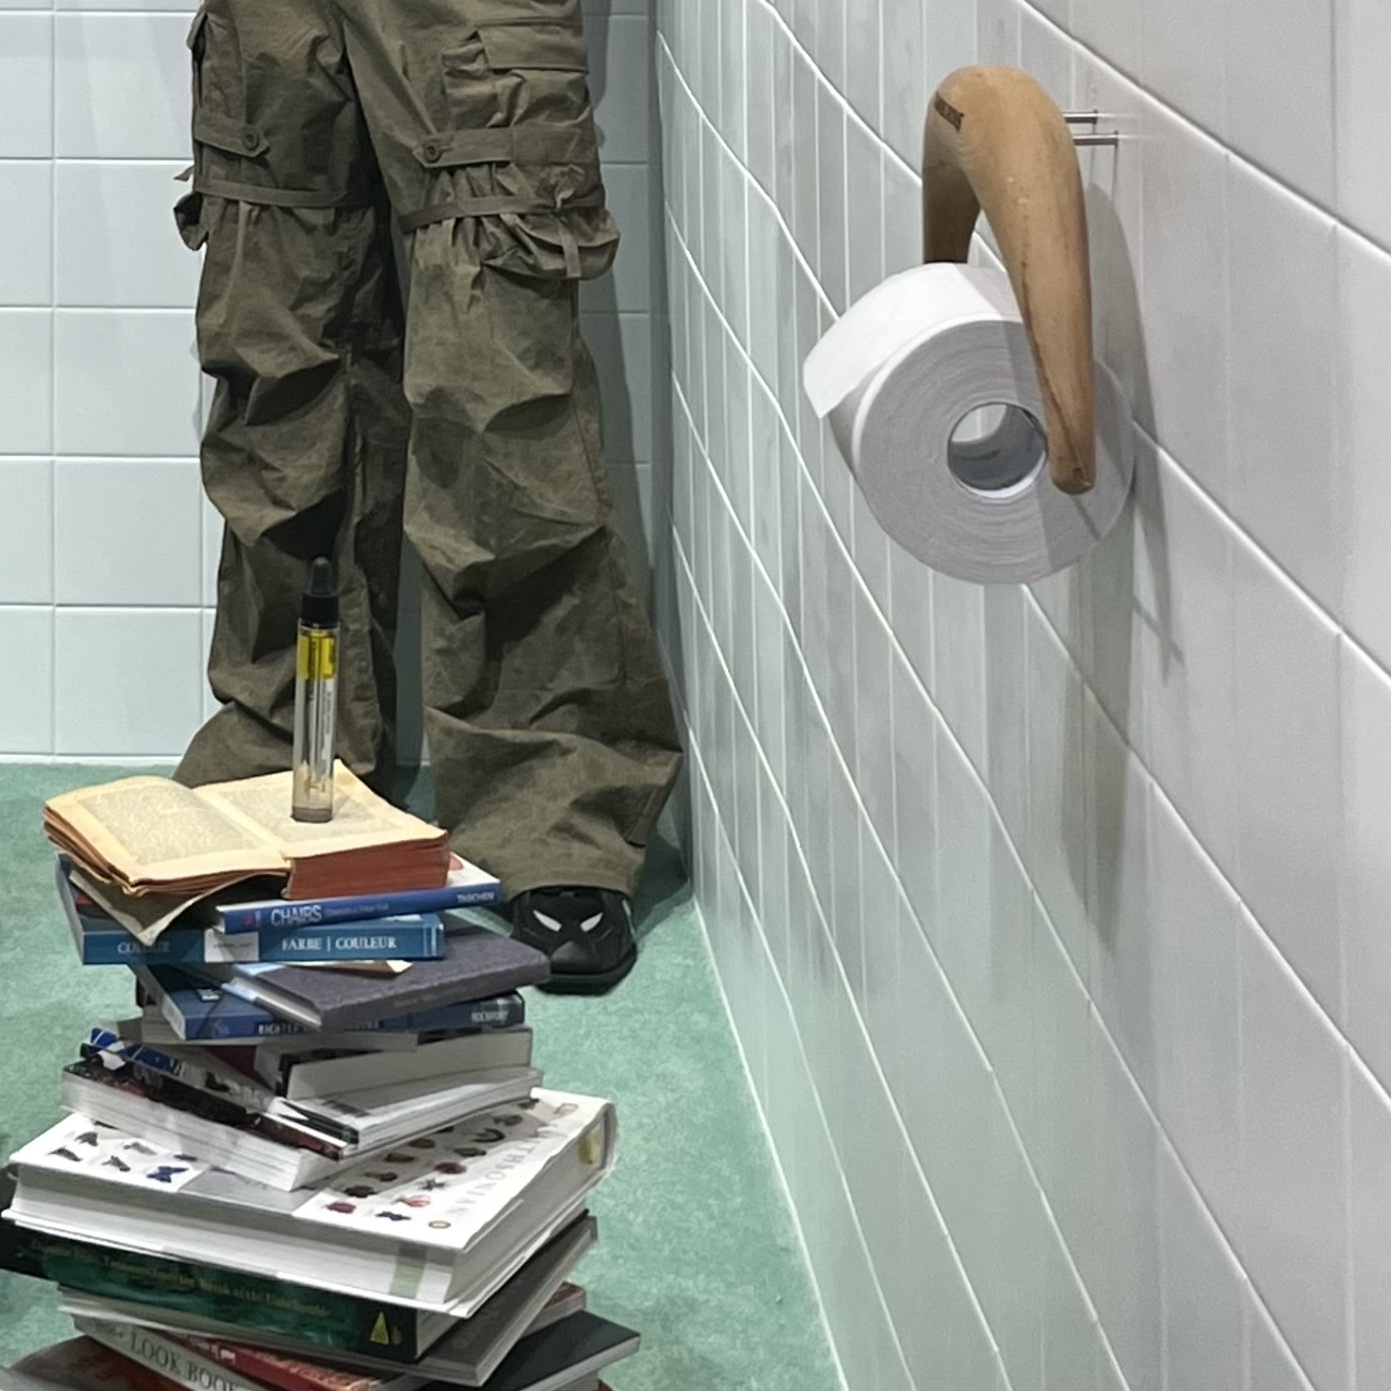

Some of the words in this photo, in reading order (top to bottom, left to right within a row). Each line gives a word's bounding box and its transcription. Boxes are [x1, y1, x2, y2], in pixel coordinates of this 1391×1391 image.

[282, 936, 322, 951] FARBE
[334, 935, 397, 951] COULEUR
[129, 1324, 184, 1379] LOOK
